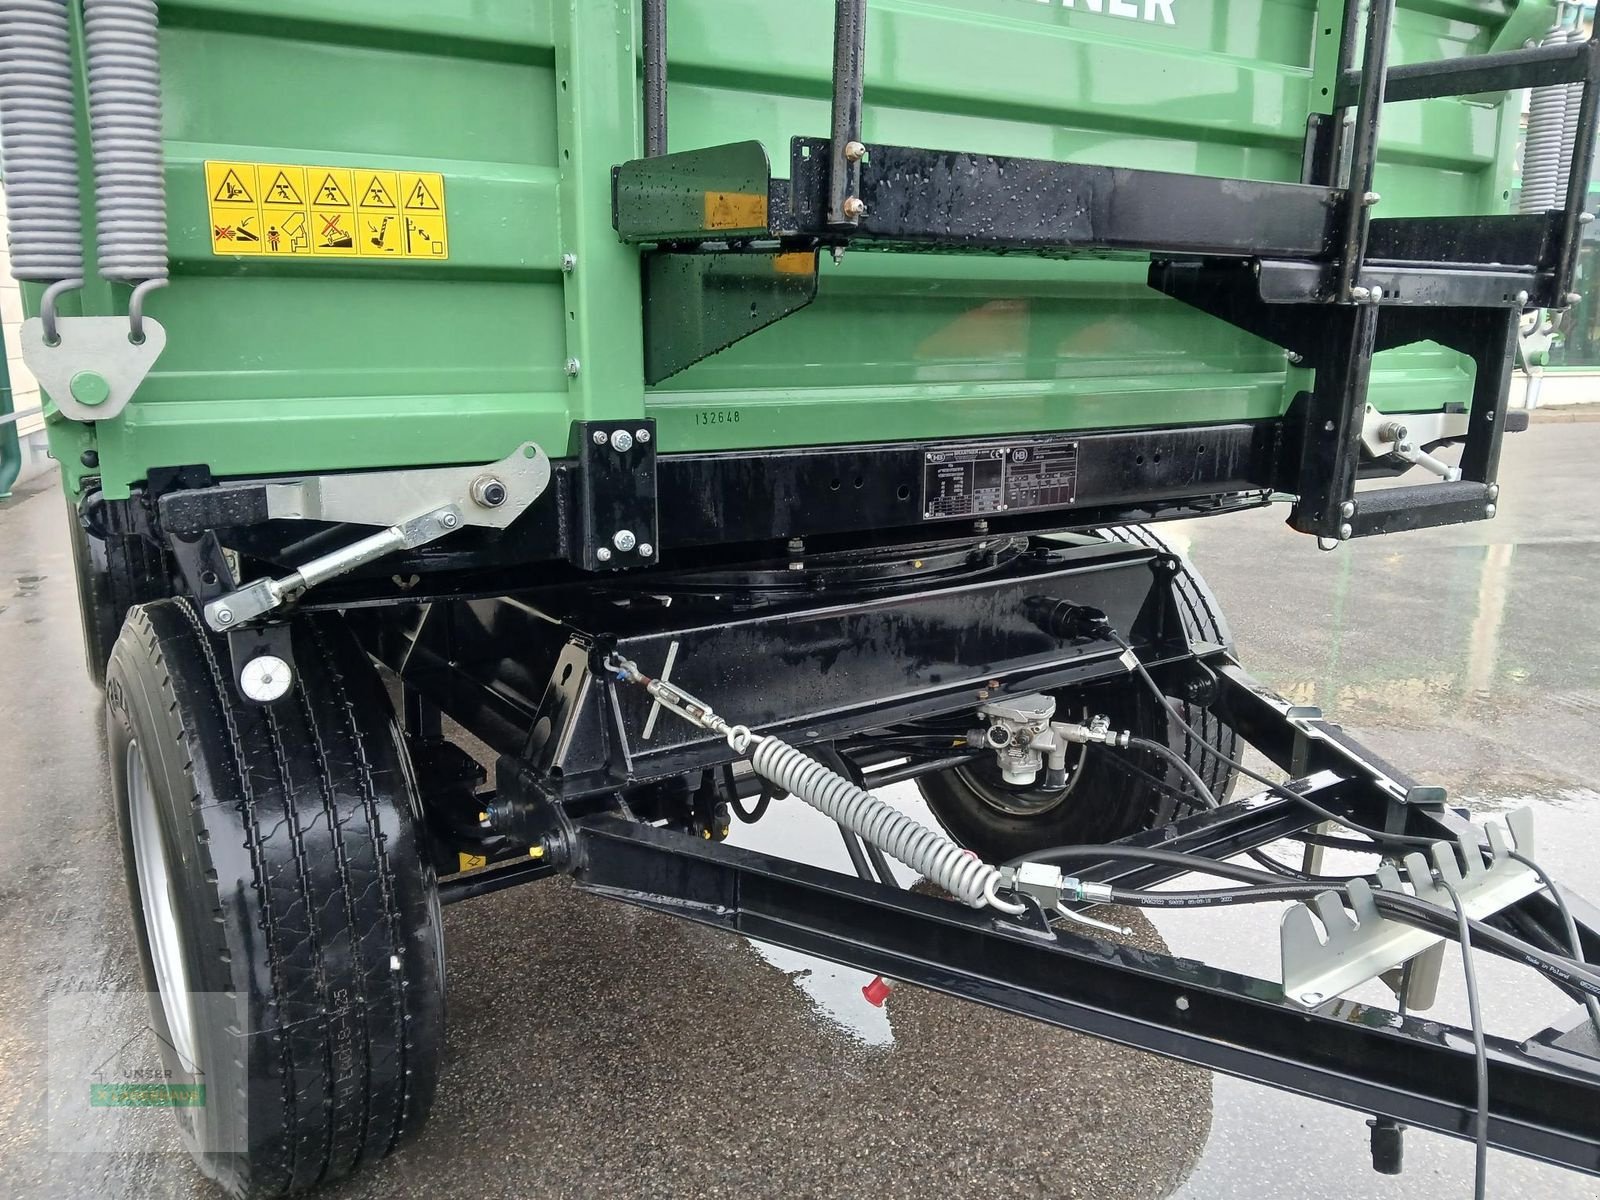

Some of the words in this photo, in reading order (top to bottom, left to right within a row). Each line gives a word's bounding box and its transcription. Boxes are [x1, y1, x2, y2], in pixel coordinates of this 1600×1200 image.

[695, 410, 740, 425] 132648
[1525, 955, 1540, 965] Made
[1549, 966, 1570, 980] Poland
